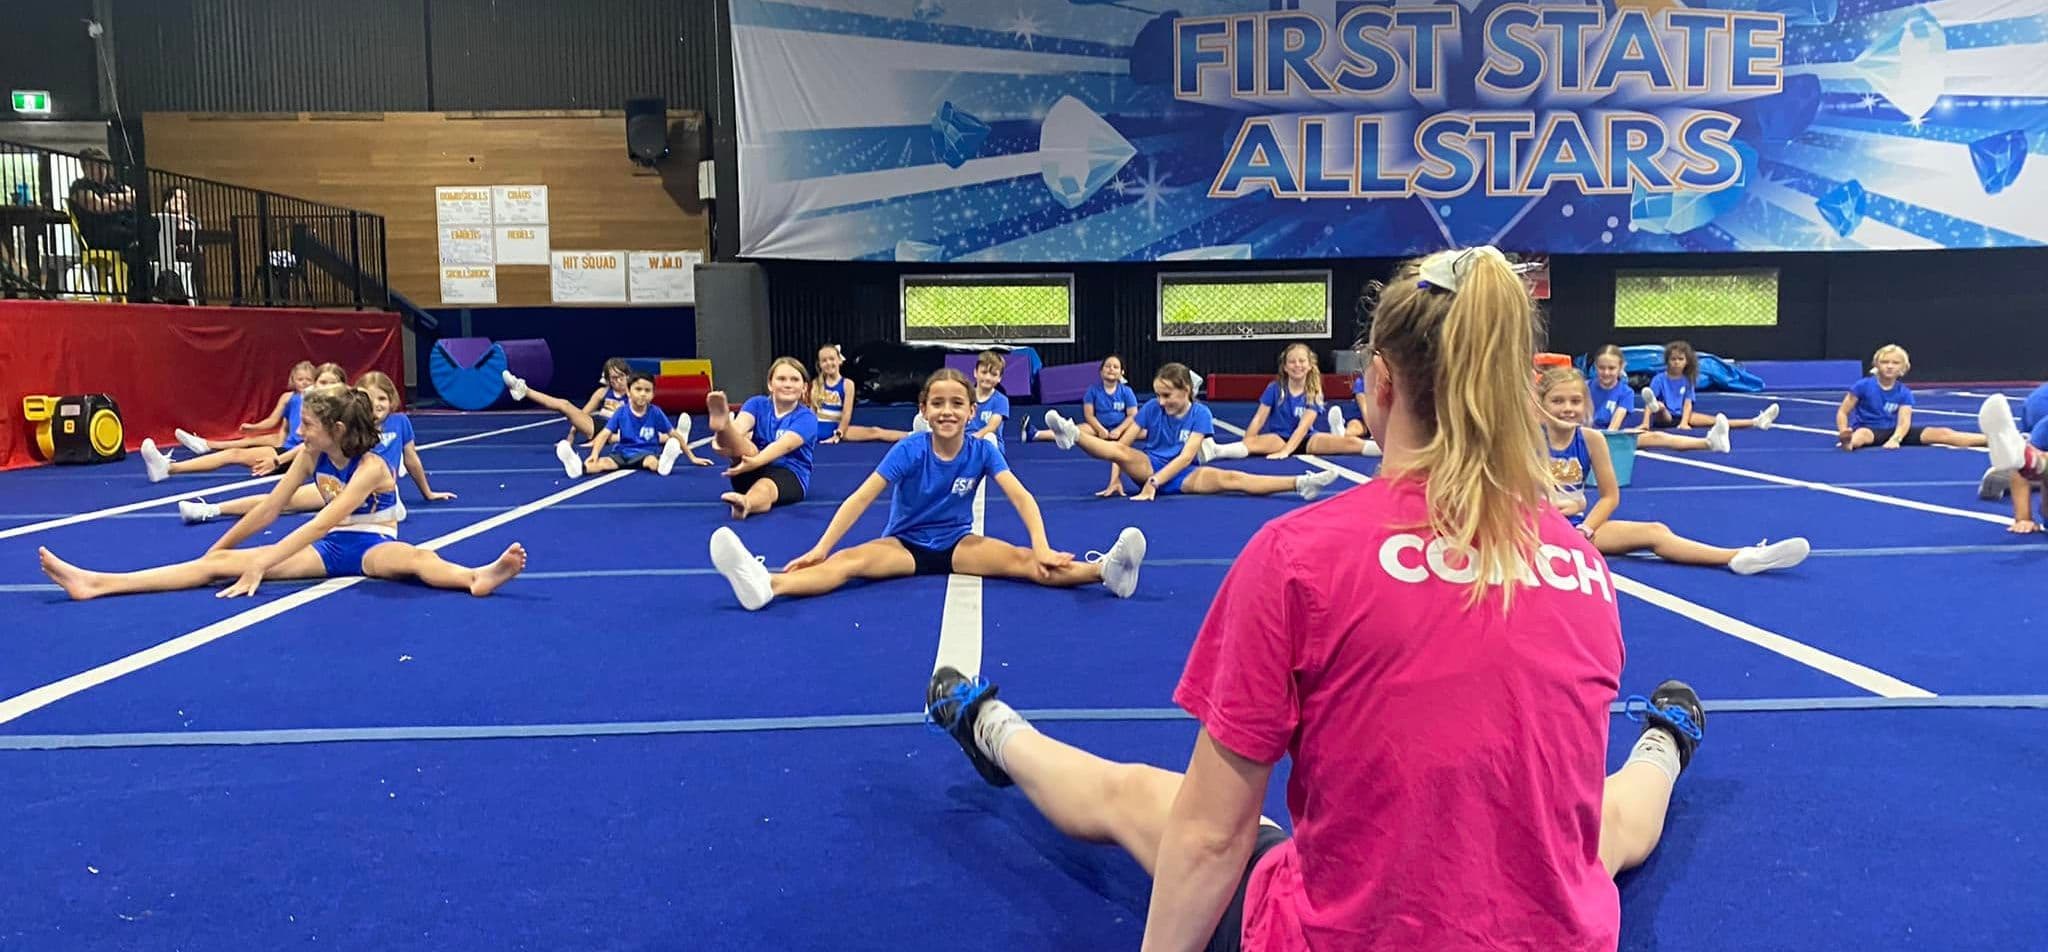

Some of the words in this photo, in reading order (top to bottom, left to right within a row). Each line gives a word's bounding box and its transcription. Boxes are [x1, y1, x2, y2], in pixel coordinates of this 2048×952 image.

[1174, 5, 1461, 98] FIRST
[1475, 5, 1785, 95] STATE
[1207, 110, 1743, 199] ALLSTARS
[562, 256, 579, 270] HIT
[582, 256, 617, 270] SQUAD
